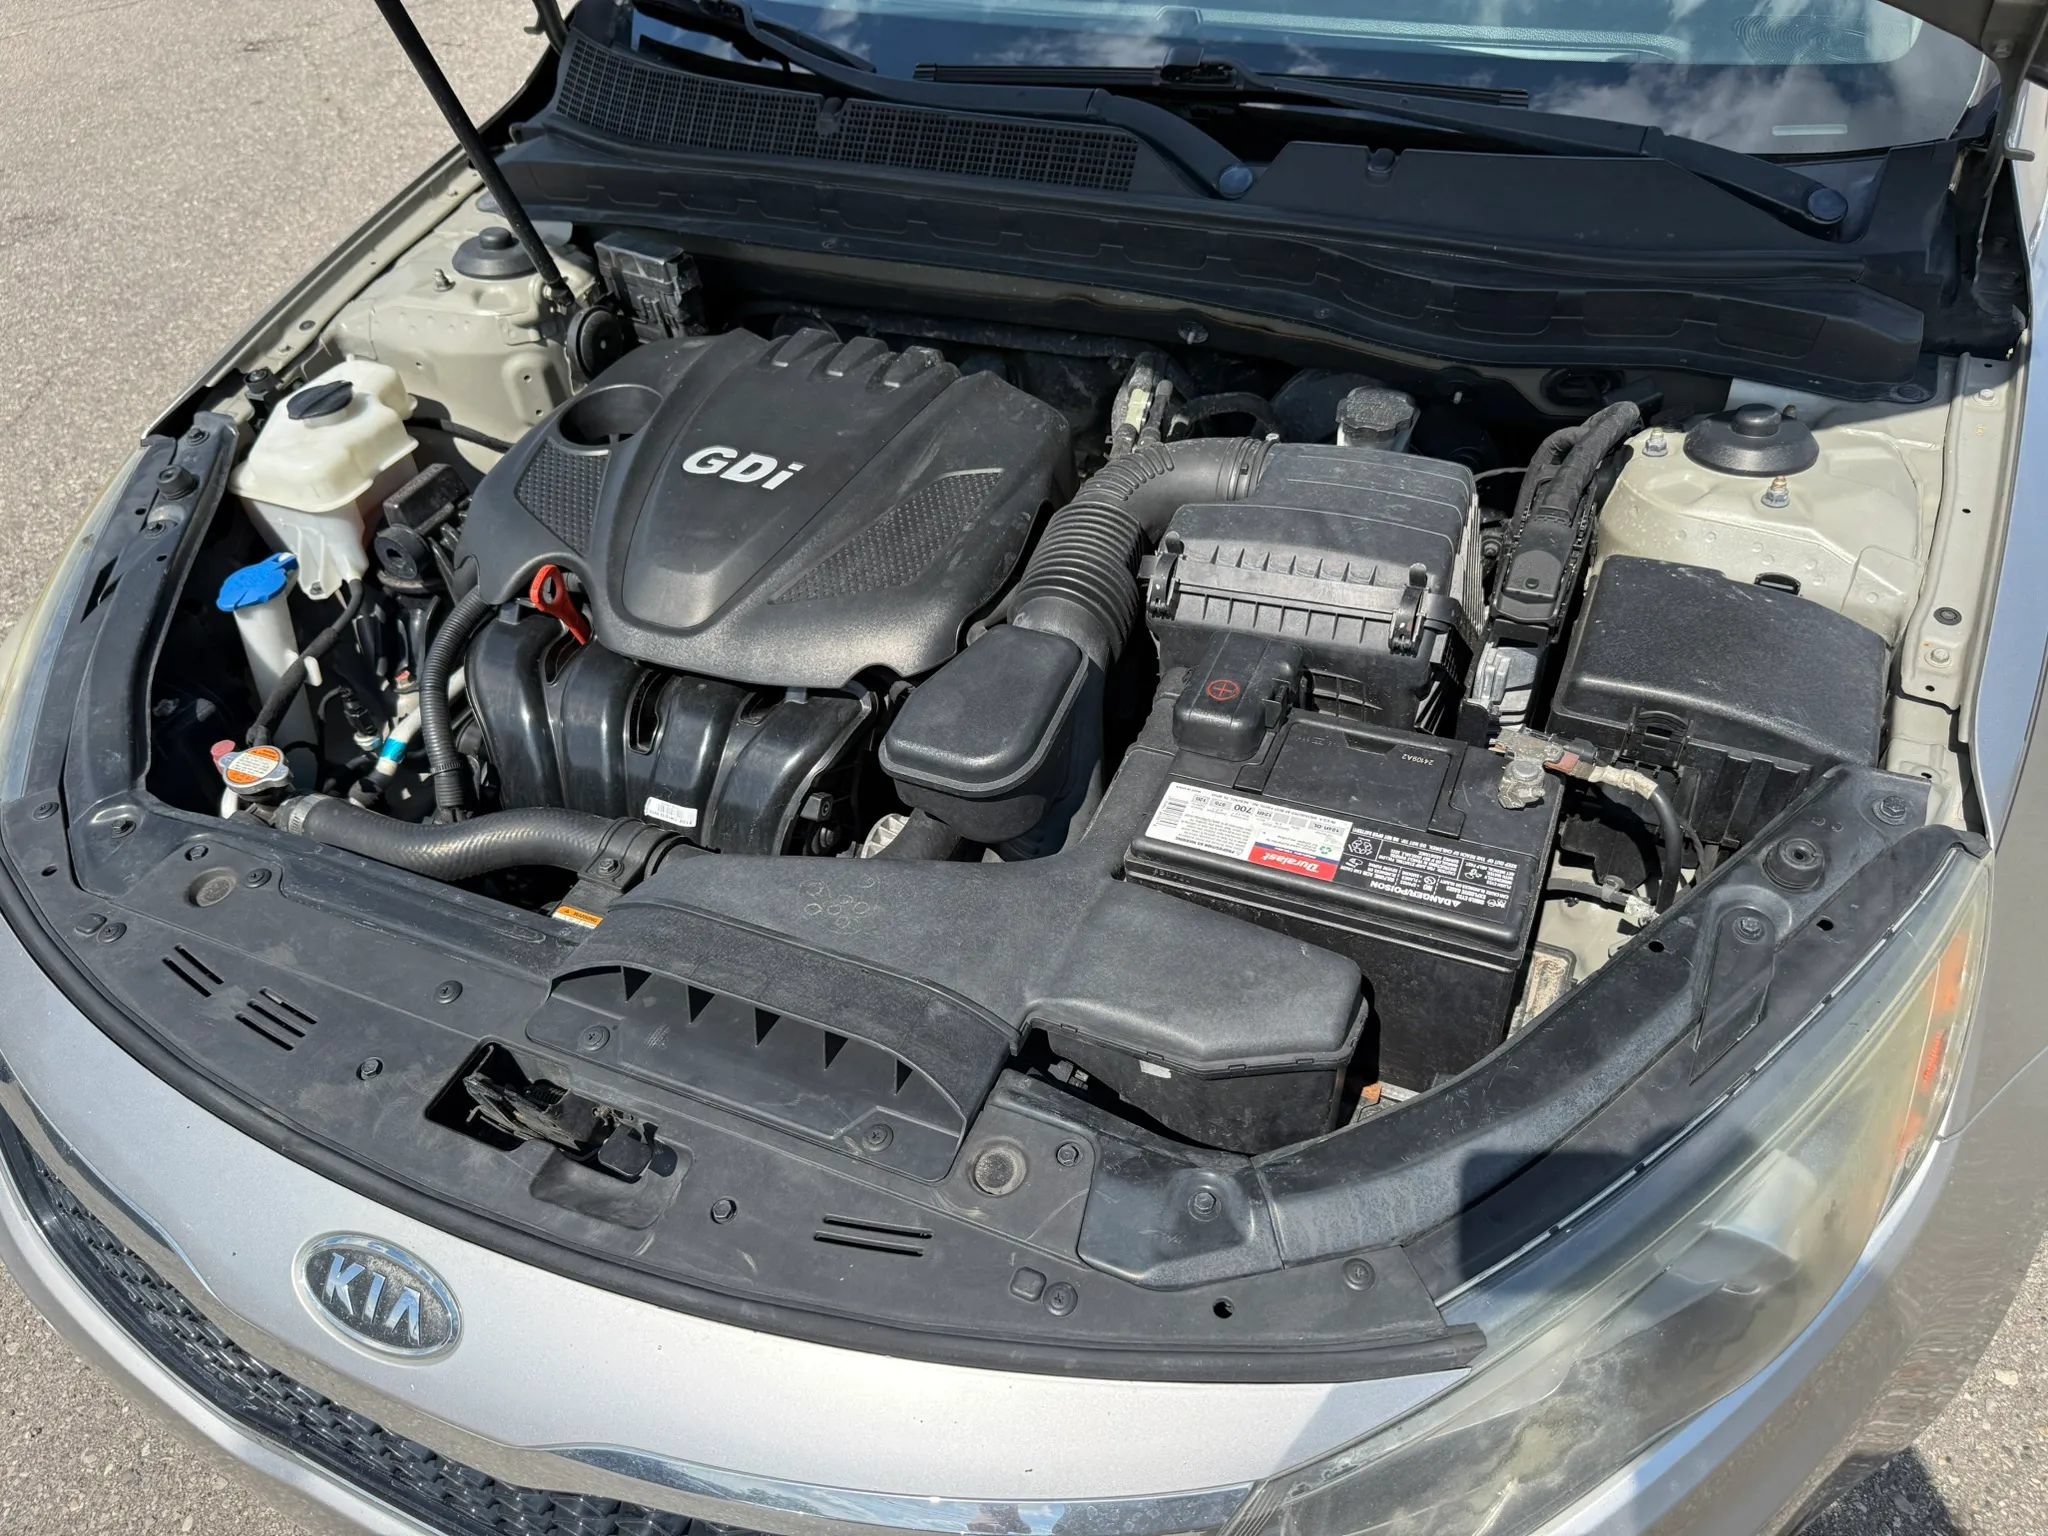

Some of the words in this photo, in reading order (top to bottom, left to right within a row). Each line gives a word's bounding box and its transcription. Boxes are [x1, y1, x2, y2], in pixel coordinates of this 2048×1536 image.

[682, 445, 805, 490] GDi
[1233, 803, 1252, 813] 700
[1262, 853, 1320, 873] Duralast
[1370, 881, 1452, 906] DANGER/POISON
[321, 1252, 421, 1346] KIA
